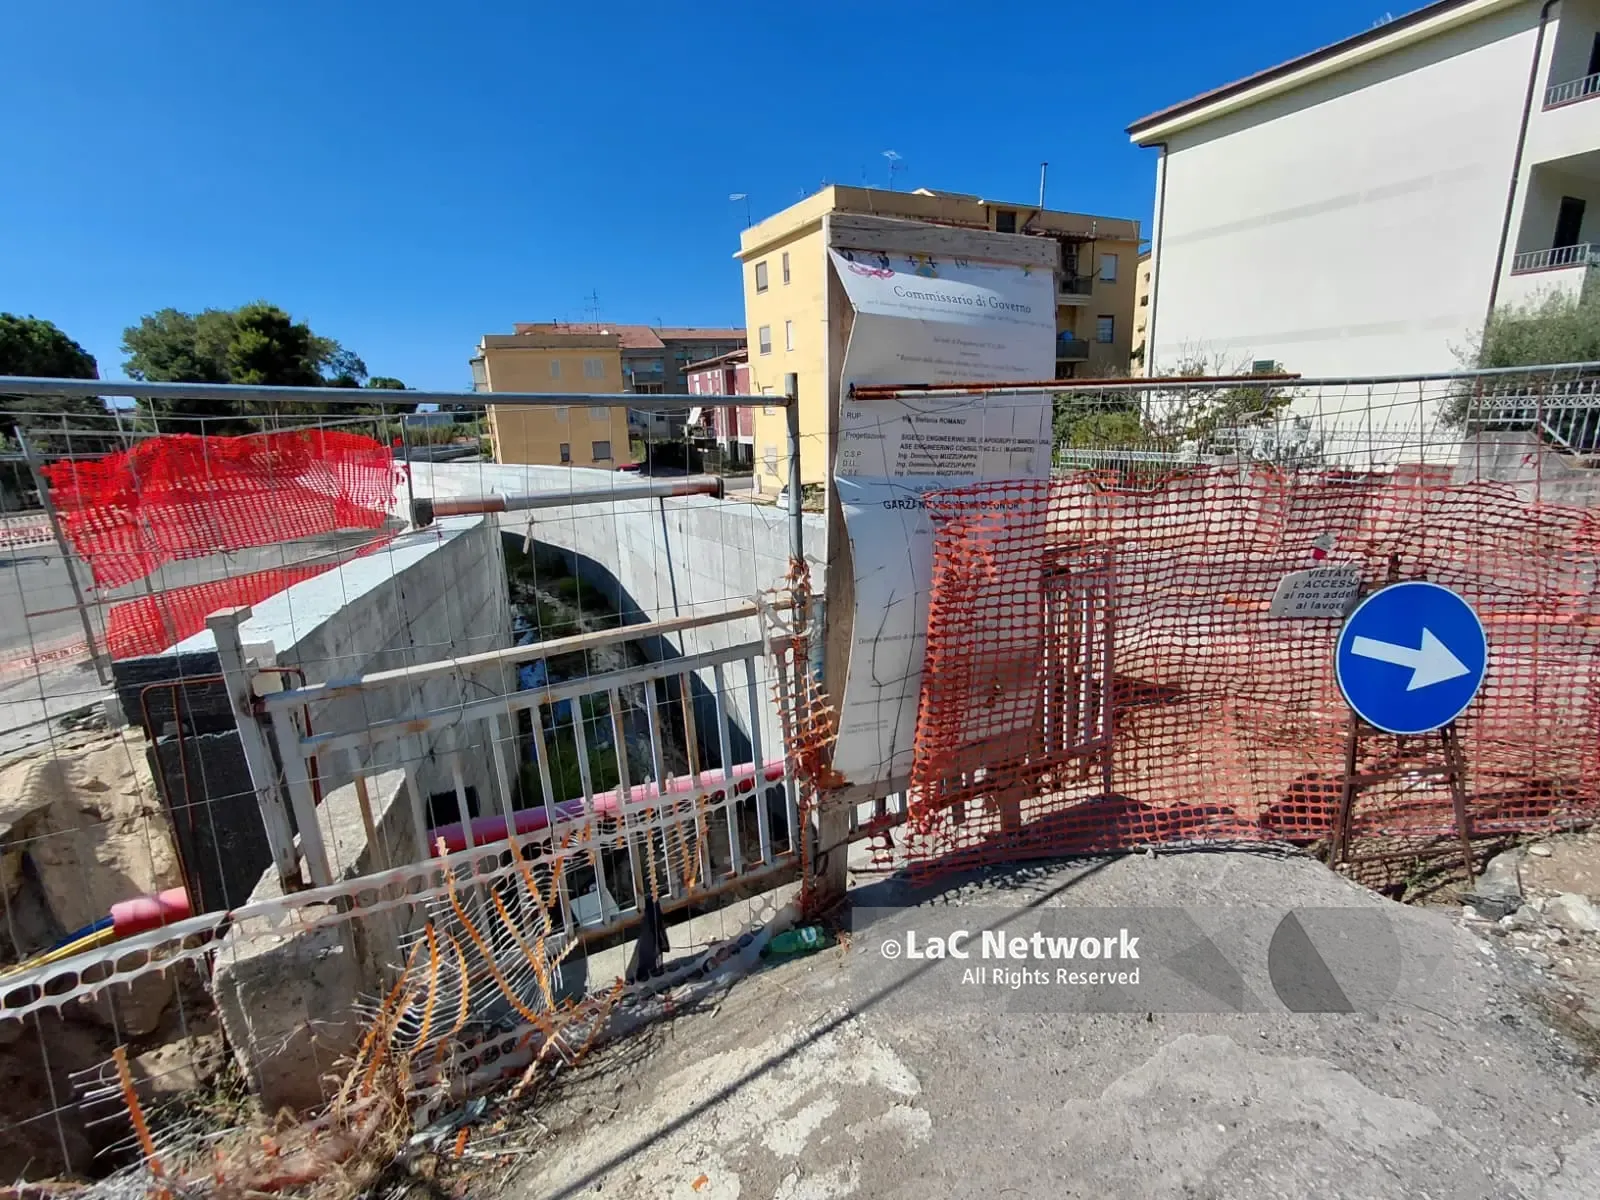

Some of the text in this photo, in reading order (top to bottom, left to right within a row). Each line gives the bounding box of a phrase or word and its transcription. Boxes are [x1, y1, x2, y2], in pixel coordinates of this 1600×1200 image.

[893, 285, 973, 306] Commissario
[975, 294, 986, 308] di
[988, 296, 1032, 314] Governo
[914, 443, 955, 452] ENGINEERING
[1294, 578, 1359, 589] L'ACCESSO
[1297, 592, 1321, 600] non
[1310, 600, 1345, 610] lavori
